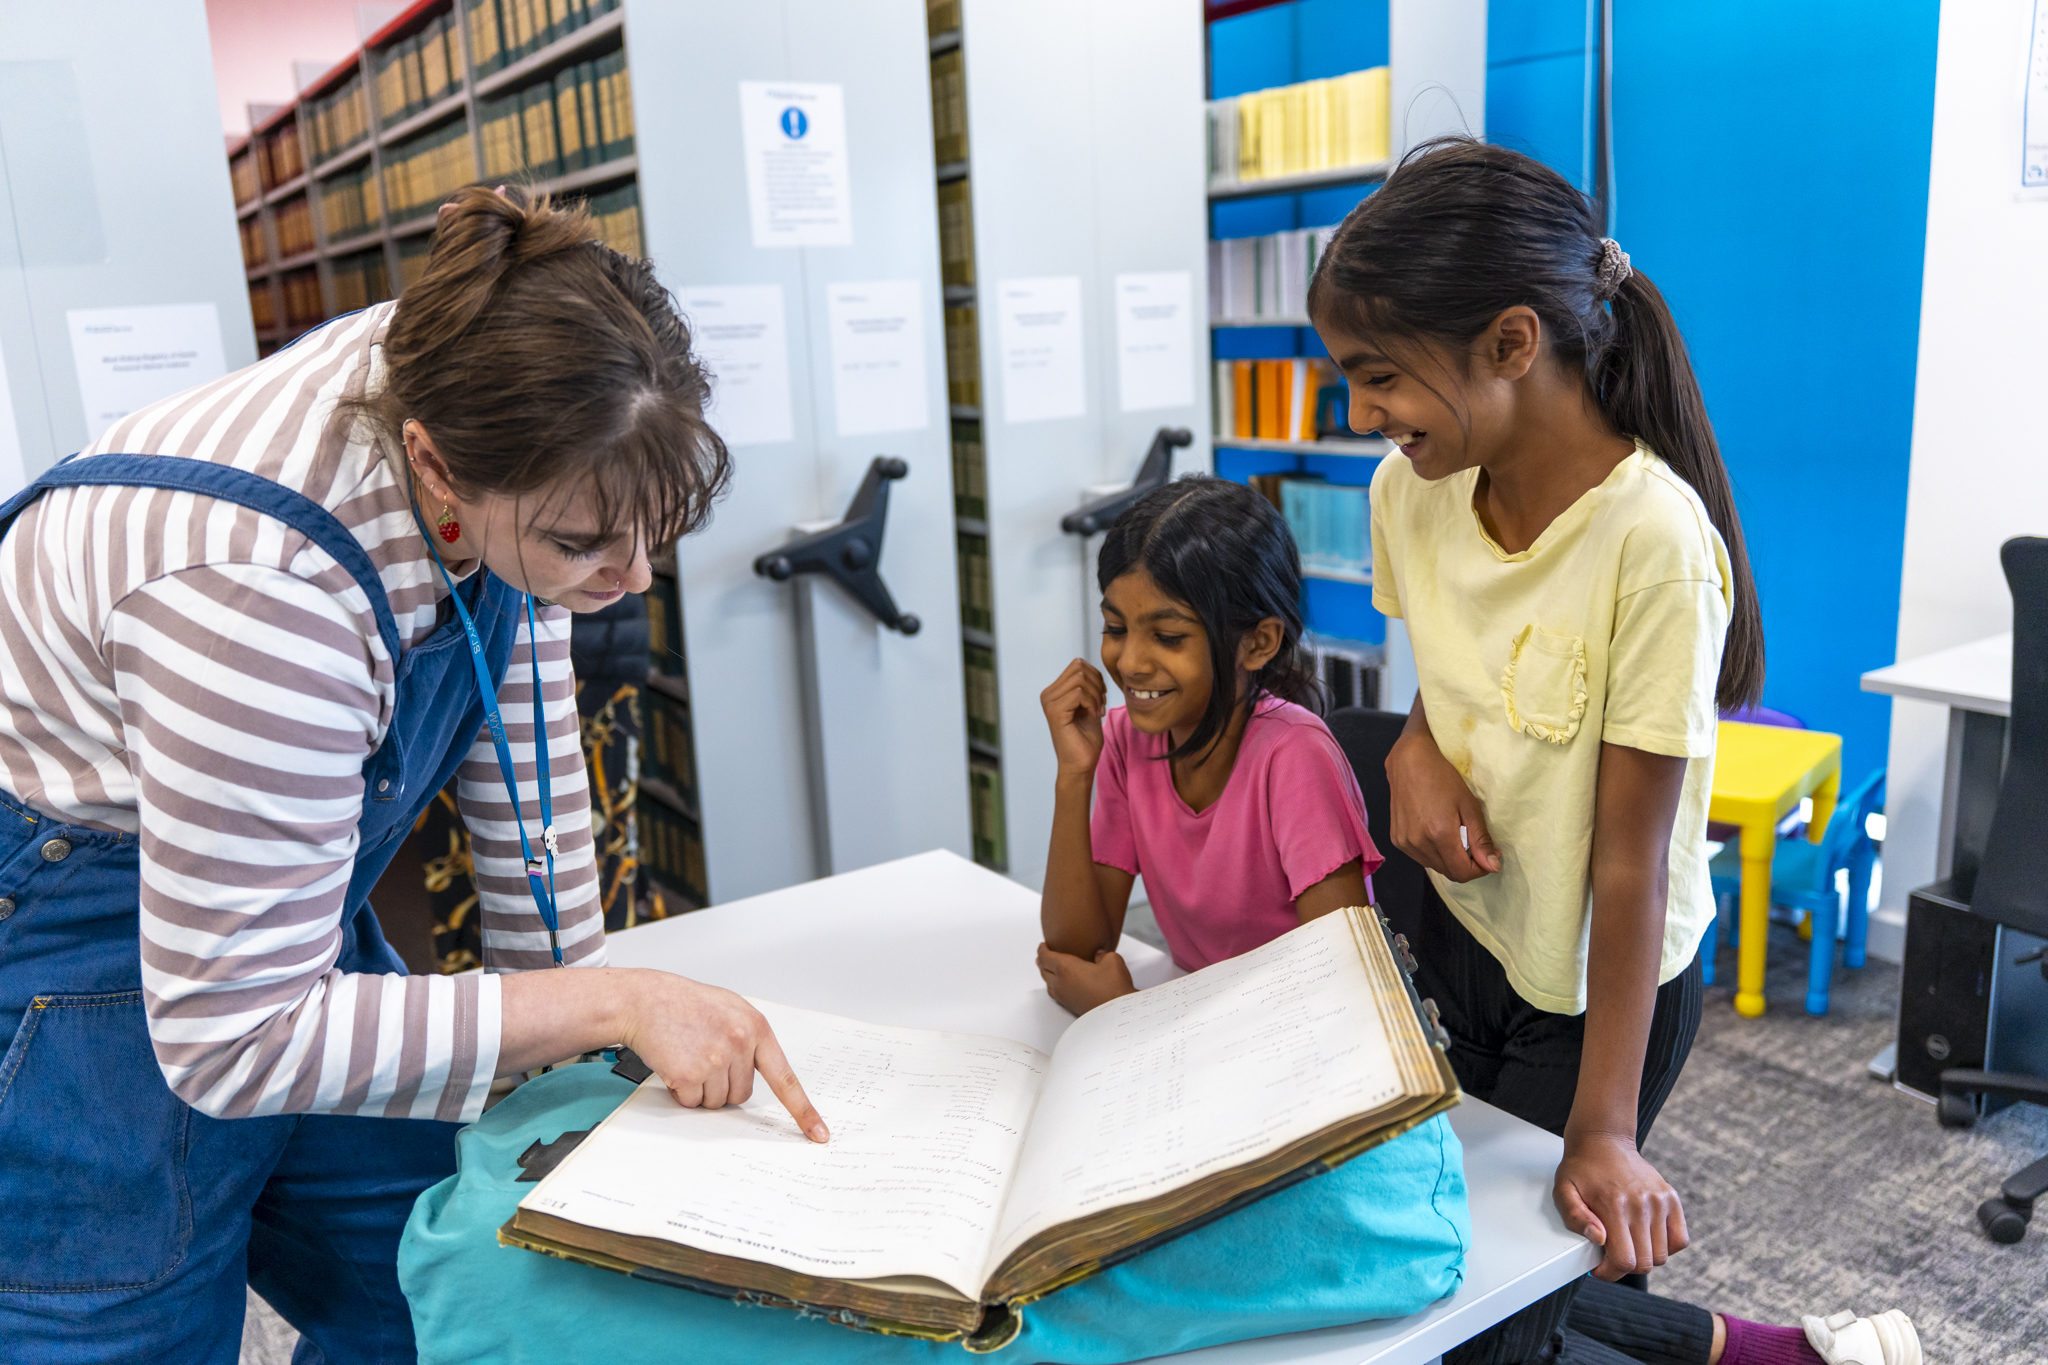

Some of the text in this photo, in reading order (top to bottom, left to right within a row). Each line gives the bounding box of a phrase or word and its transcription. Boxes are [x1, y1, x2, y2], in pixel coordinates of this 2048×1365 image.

[466, 617, 481, 655] WYJS
[489, 710, 504, 745] WYJS
[540, 771, 551, 807] WYJS
